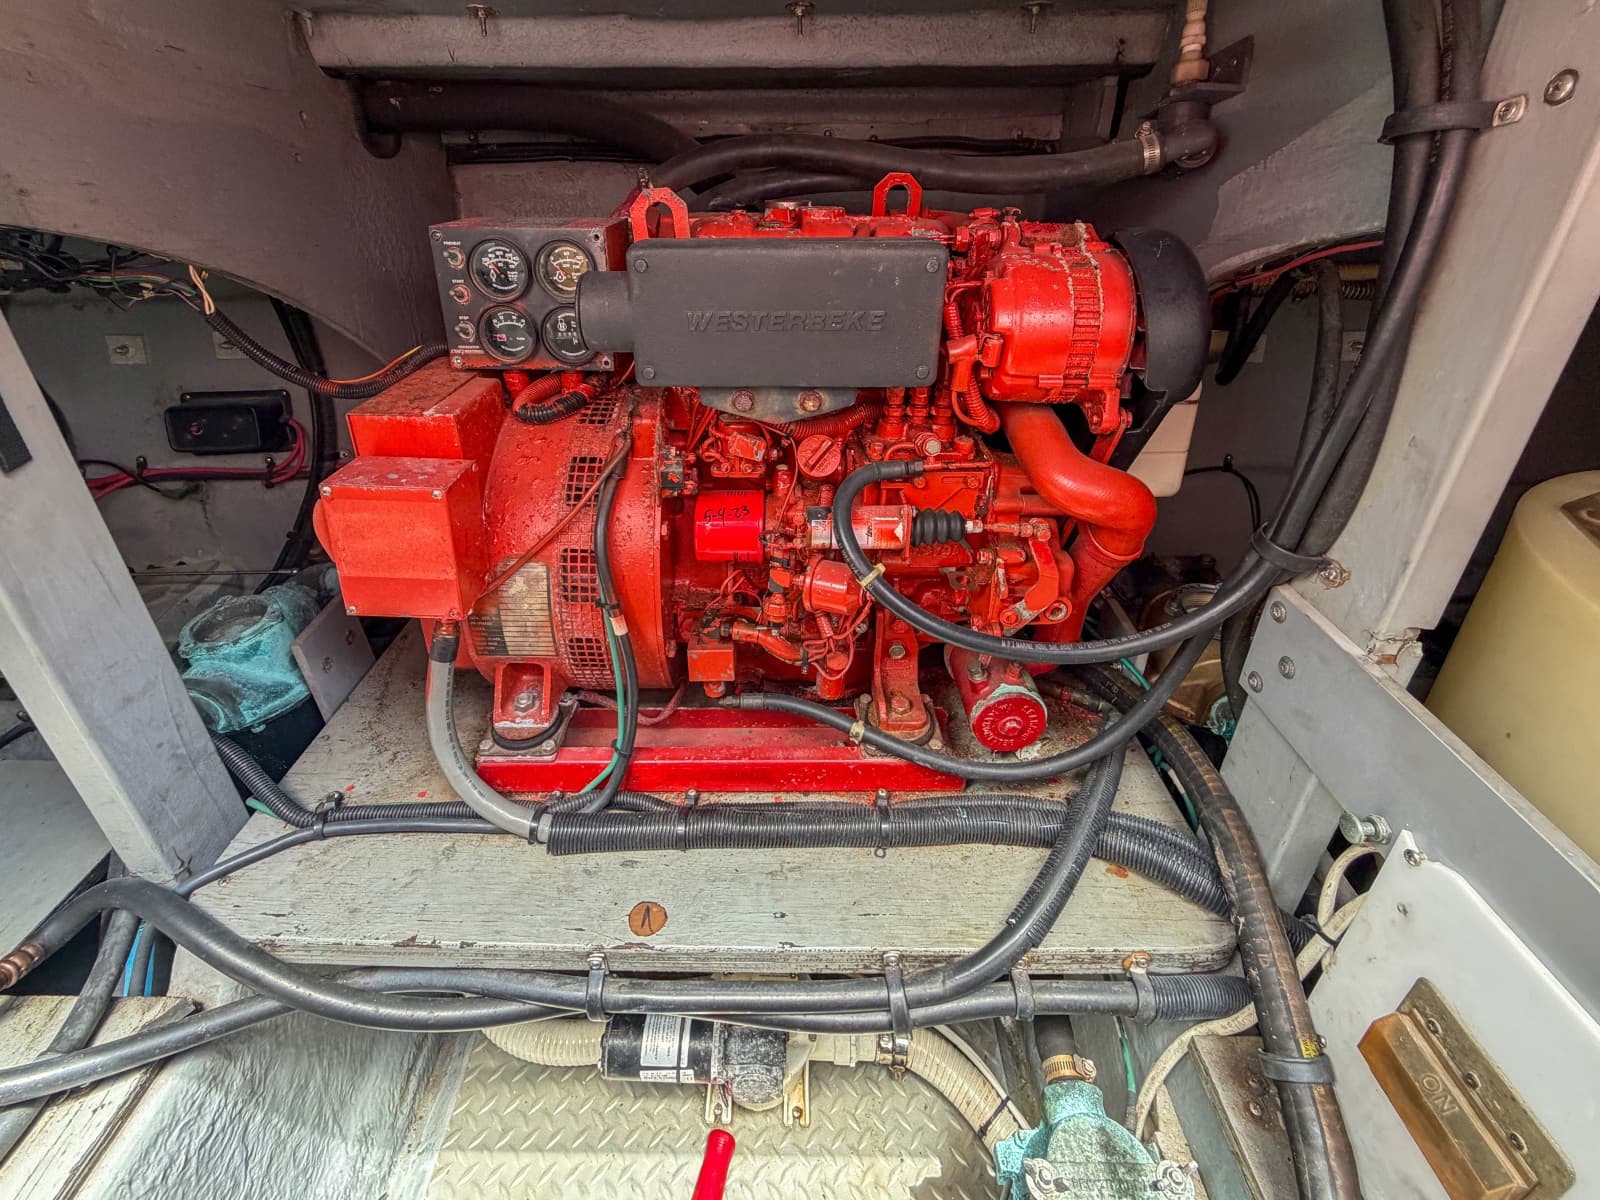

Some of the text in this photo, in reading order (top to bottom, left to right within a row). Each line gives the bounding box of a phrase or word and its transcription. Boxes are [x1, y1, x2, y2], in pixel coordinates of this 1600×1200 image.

[686, 310, 887, 332] WESTERBEKE
[704, 505, 752, 529] 5-4-23
[1421, 1073, 1459, 1116] ON
